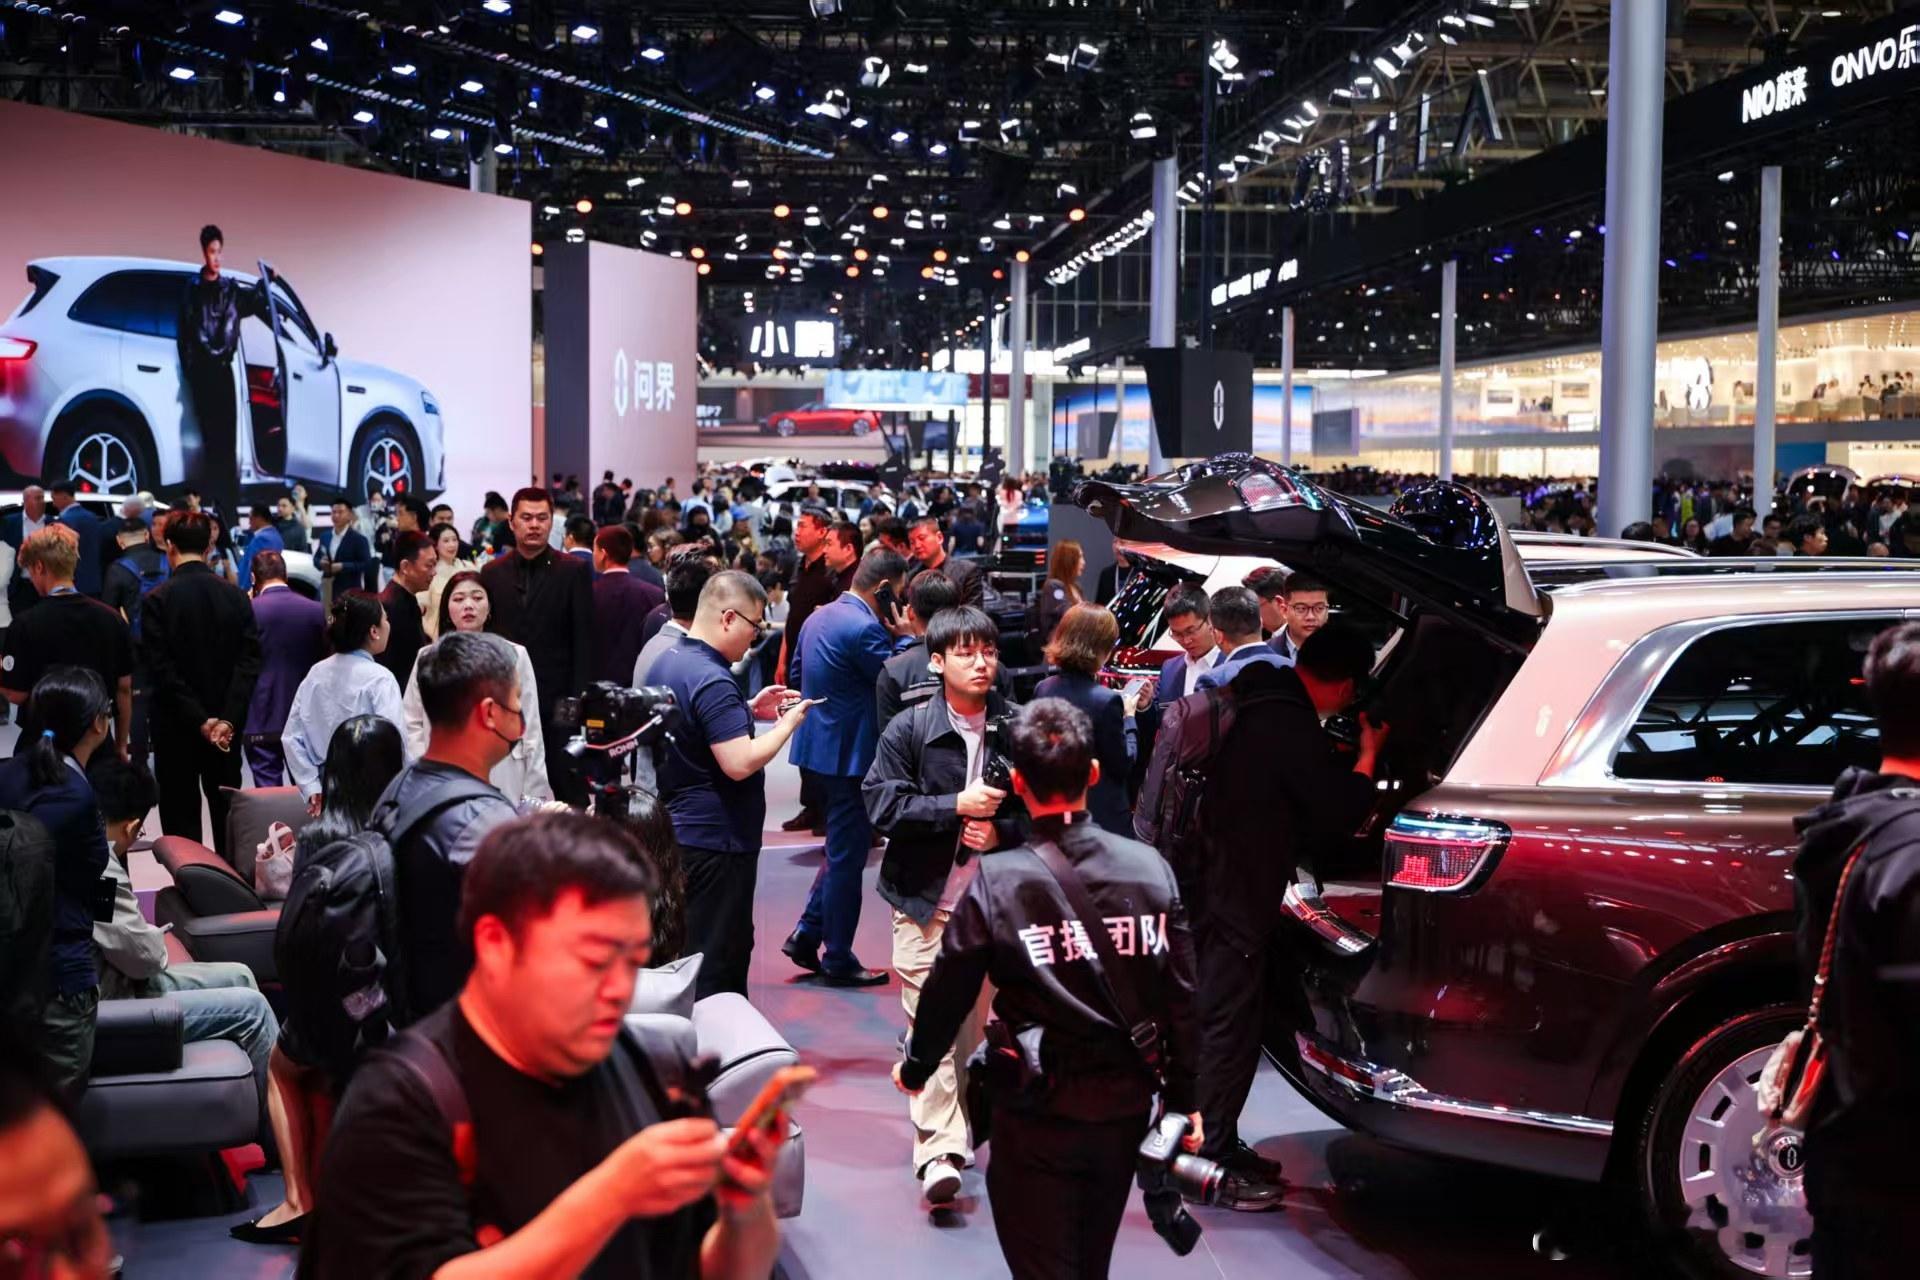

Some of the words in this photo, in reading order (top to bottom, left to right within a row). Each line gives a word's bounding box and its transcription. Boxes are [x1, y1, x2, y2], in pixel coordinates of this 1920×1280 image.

[634, 360, 675, 412] 问界
[608, 739, 639, 758] RONIN
[1017, 912, 1170, 967] 官摄团队
